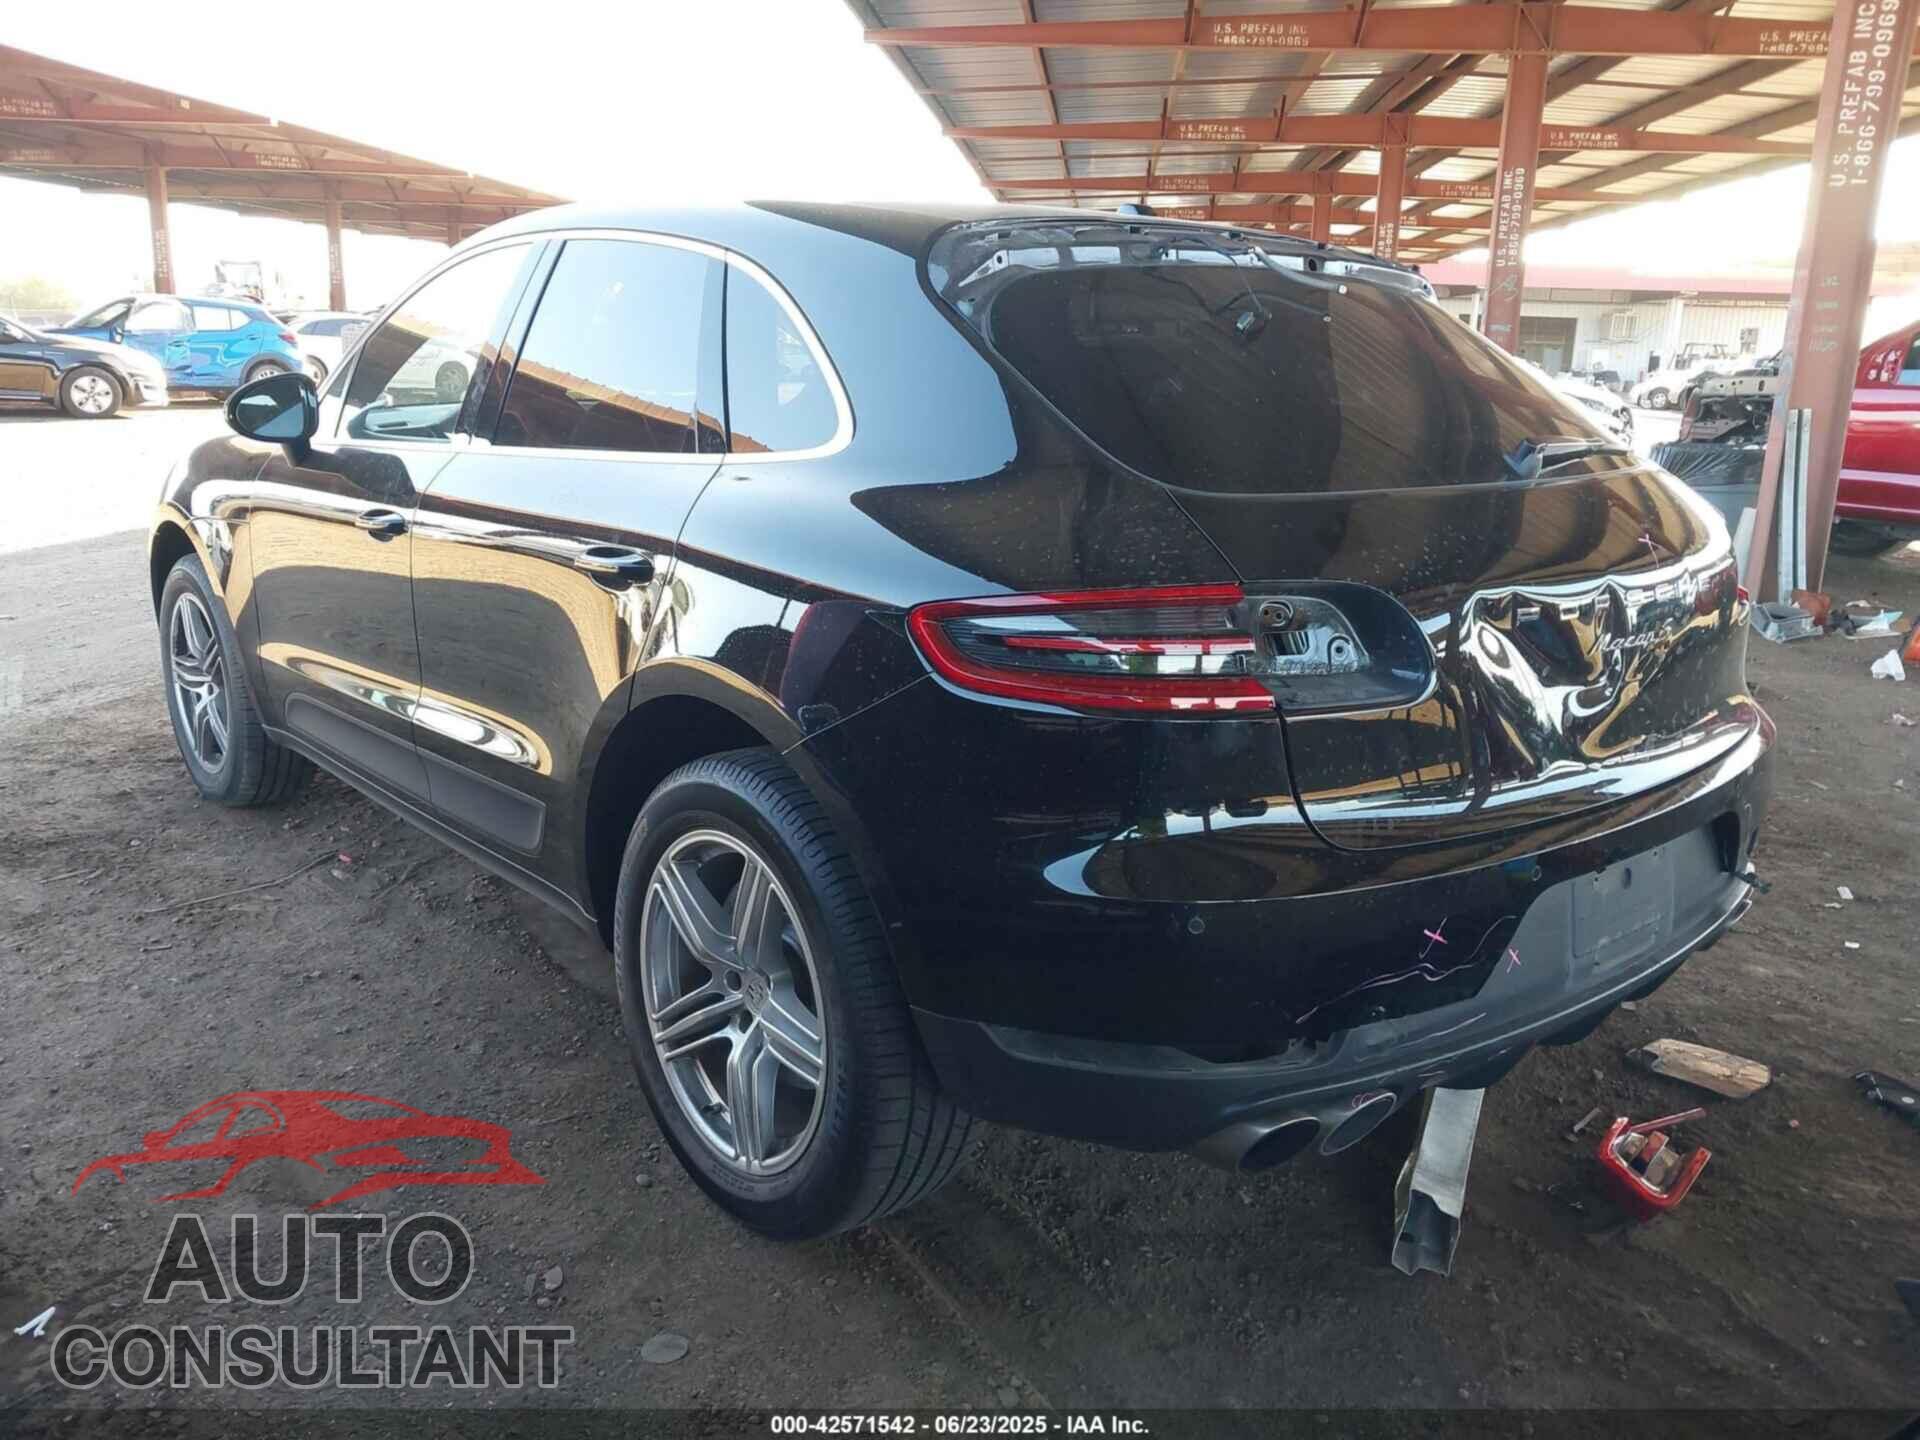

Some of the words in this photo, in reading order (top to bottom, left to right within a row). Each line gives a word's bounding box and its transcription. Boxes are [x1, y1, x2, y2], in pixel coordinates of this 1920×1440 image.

[1837, 50, 1868, 135] PREFAB
[1829, 147, 1852, 188] U.S.
[1498, 194, 1512, 239] PREFAB
